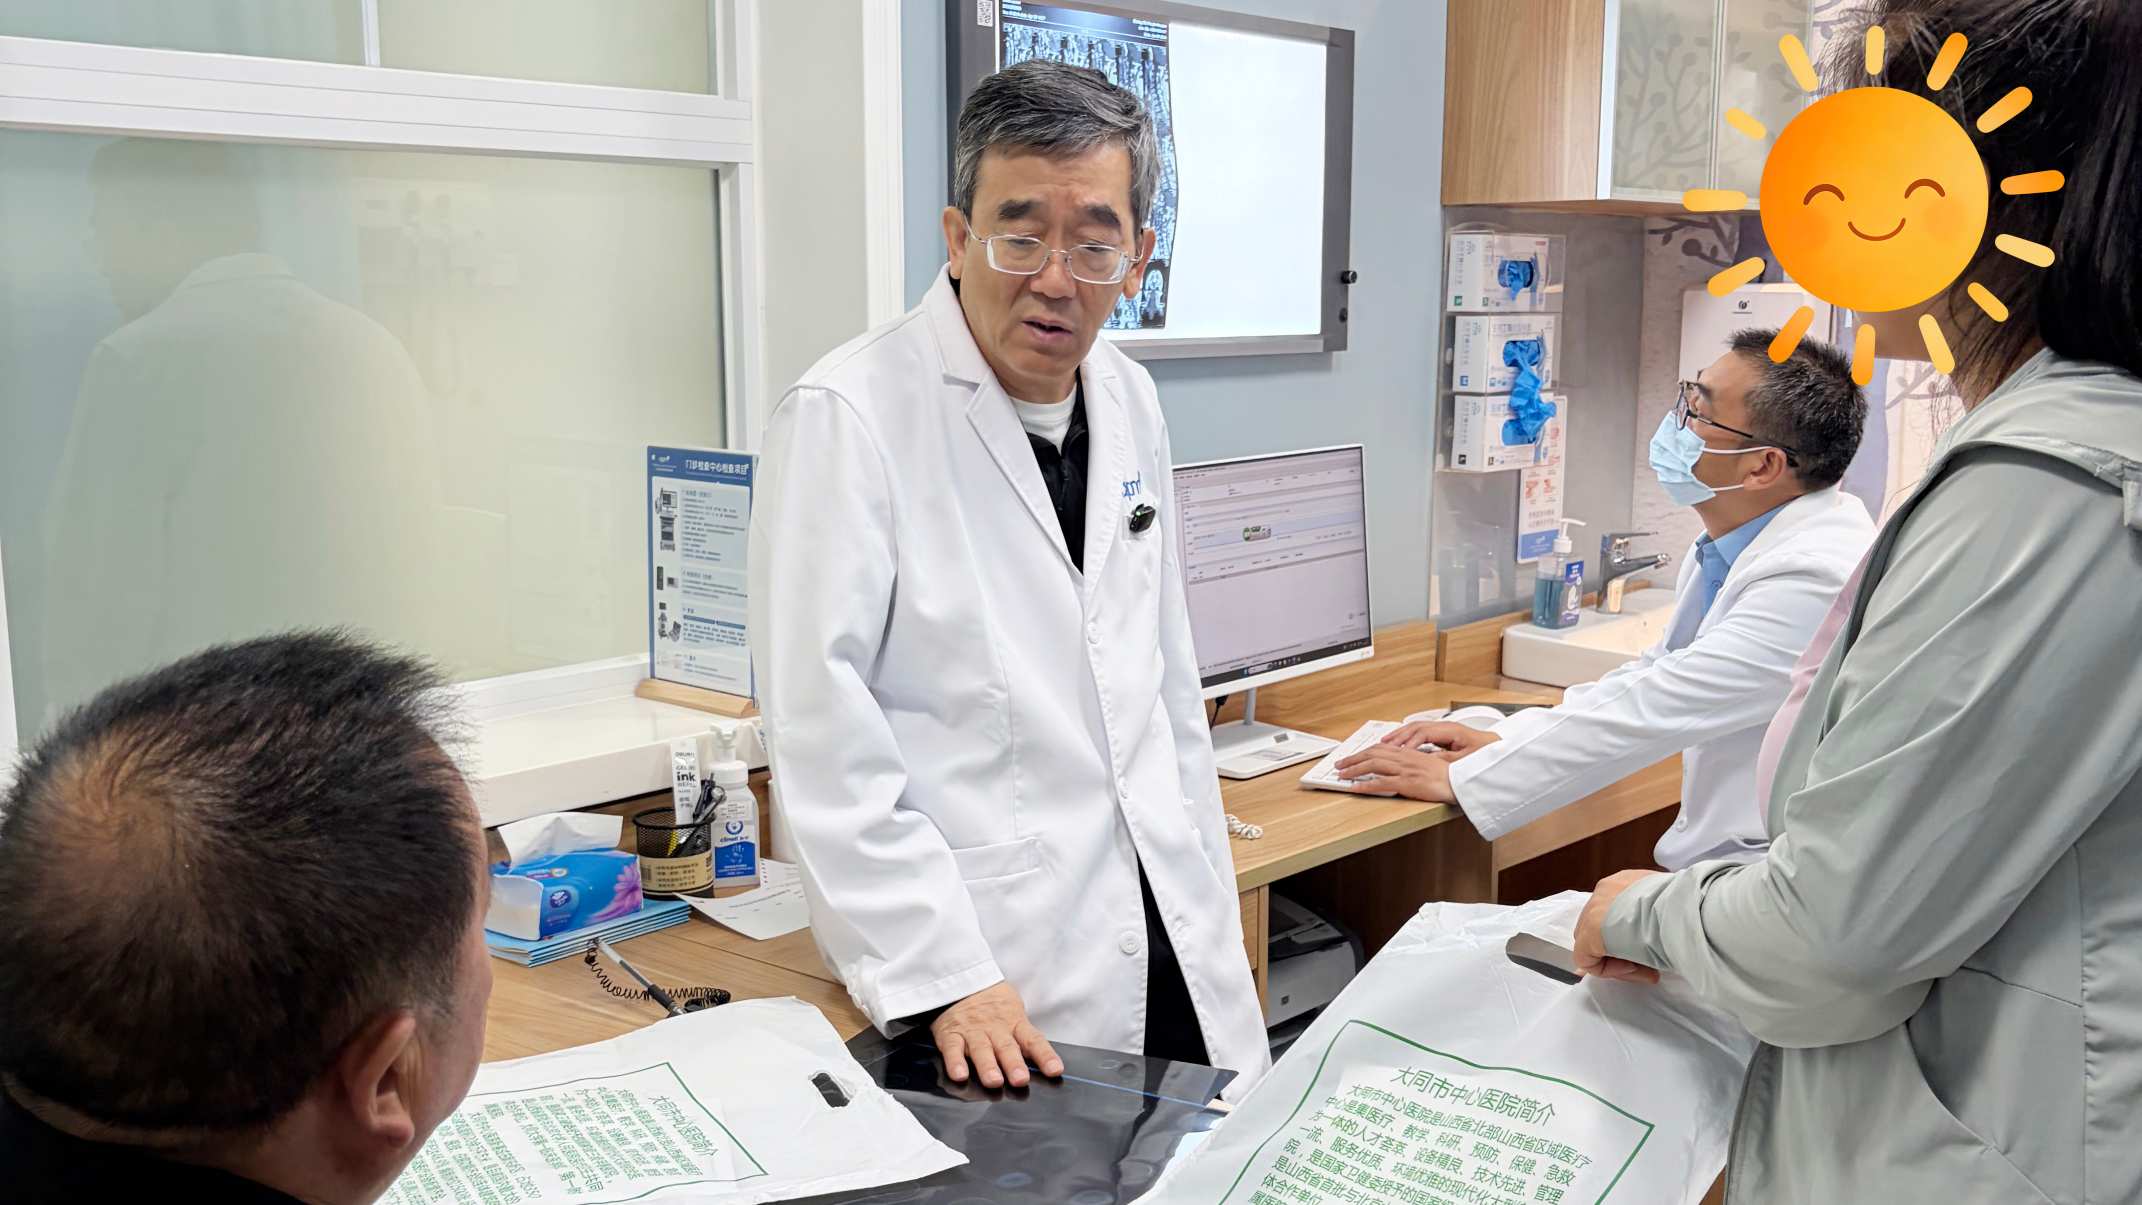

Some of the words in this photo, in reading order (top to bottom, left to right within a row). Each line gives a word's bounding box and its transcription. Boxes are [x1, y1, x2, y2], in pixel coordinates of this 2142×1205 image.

[676, 771, 695, 781] ink
[1390, 1066, 1556, 1127] 大同市中心医院简介
